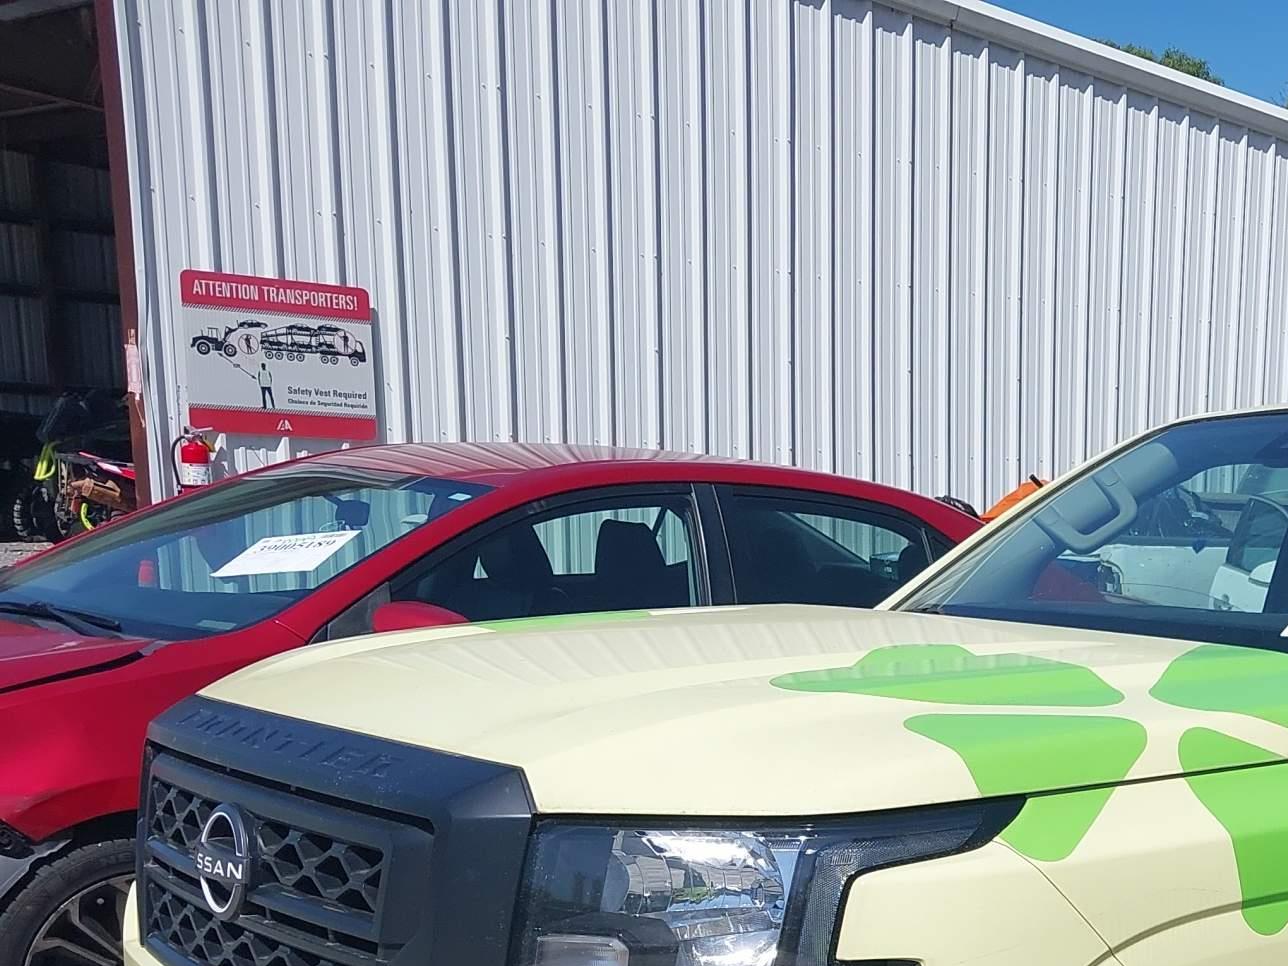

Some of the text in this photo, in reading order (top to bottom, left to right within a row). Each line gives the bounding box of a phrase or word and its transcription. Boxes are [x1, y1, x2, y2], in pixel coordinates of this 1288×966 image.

[192, 279, 358, 311] ATTENTION TRANSPORTERS!
[287, 386, 367, 400] Safety Vest Required
[174, 708, 402, 778] FRONTIER
[196, 851, 243, 880] SSAN
